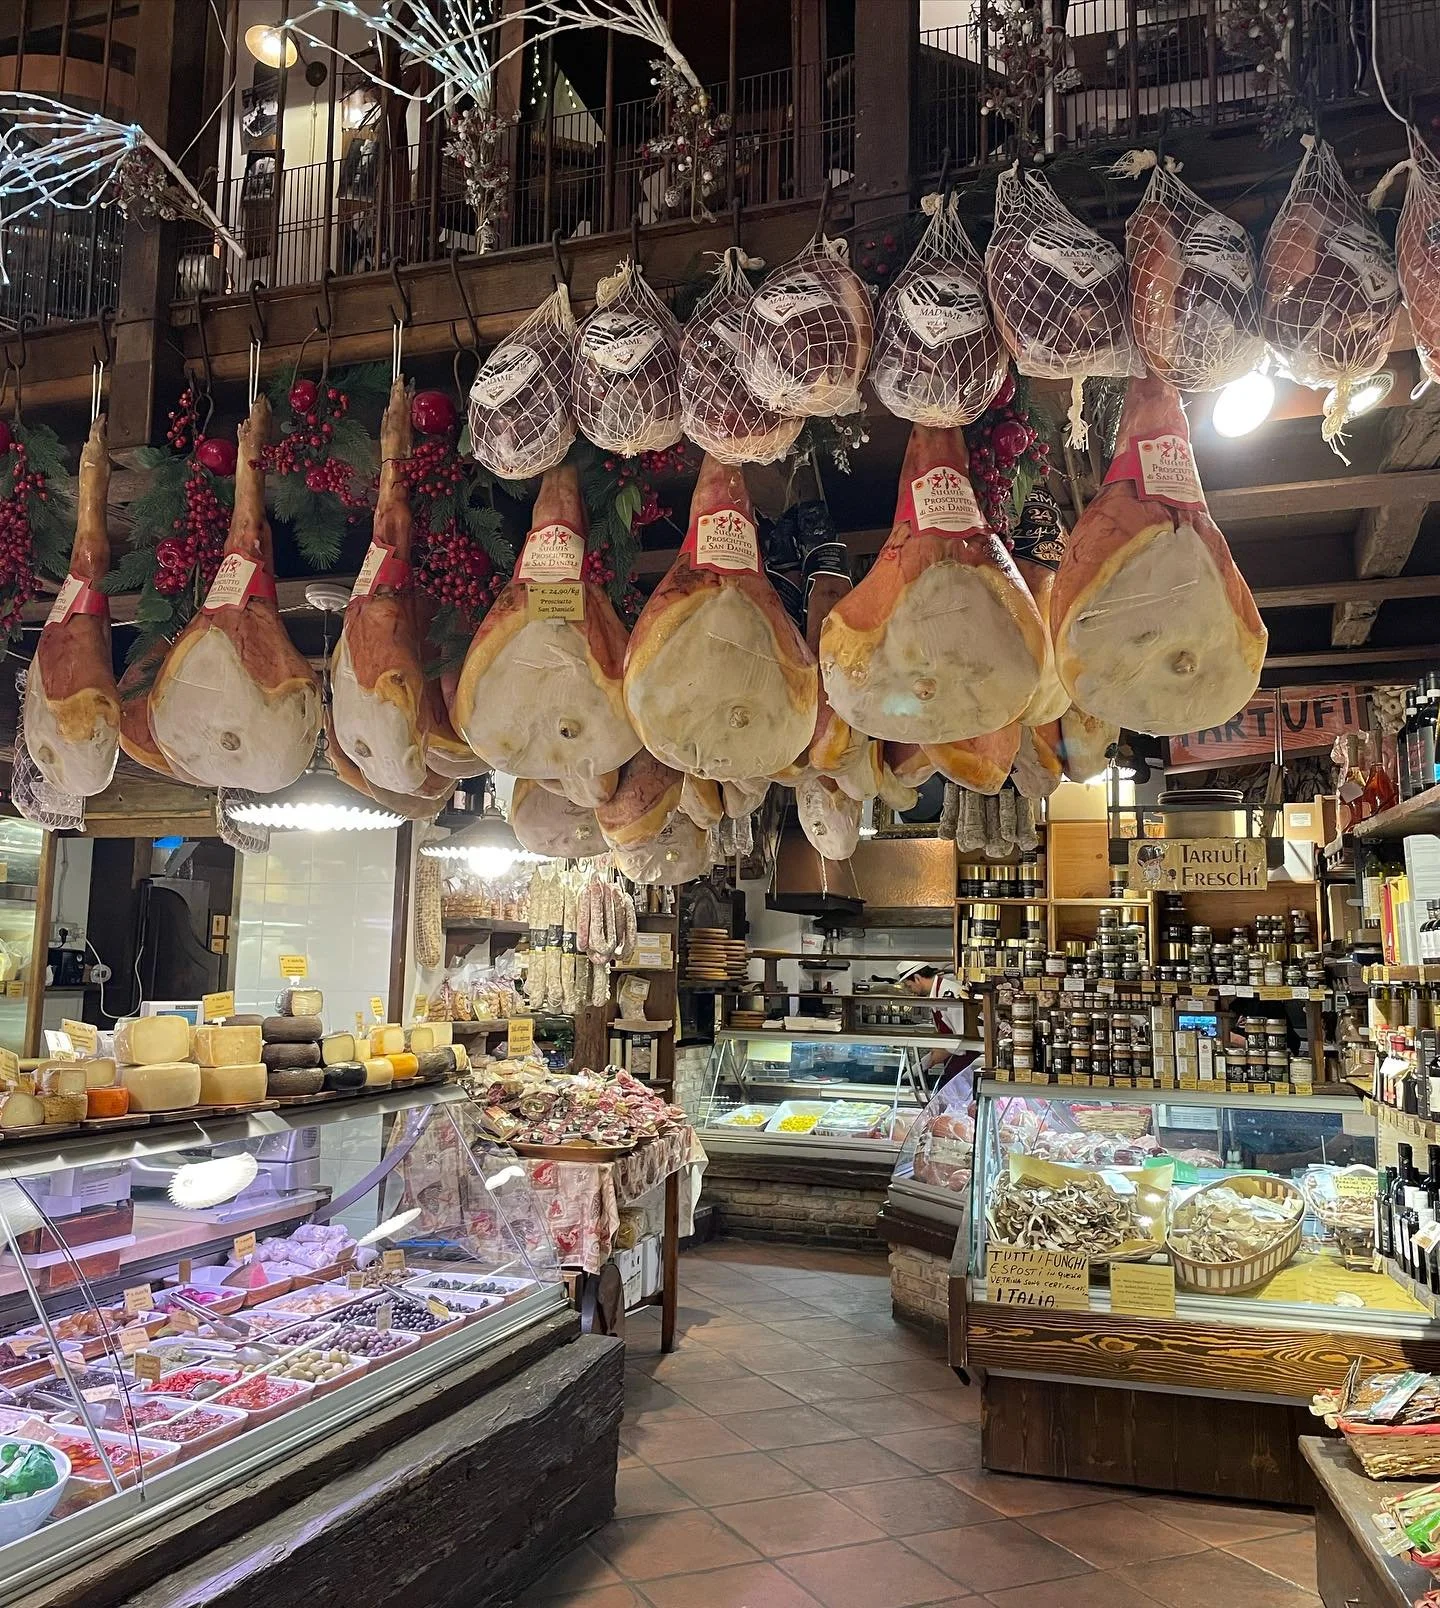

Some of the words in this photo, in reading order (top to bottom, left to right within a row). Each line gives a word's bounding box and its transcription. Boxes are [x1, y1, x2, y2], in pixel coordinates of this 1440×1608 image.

[919, 307, 964, 322] MADAME
[1155, 472, 1173, 480] SAN
[923, 496, 973, 507] PROSCIUTTO
[927, 504, 946, 514] SAN
[705, 535, 753, 549] PROSCIUTTO
[708, 542, 724, 550] SAN
[726, 543, 757, 558] DANIELE
[530, 552, 576, 560] PROSCIUTTO
